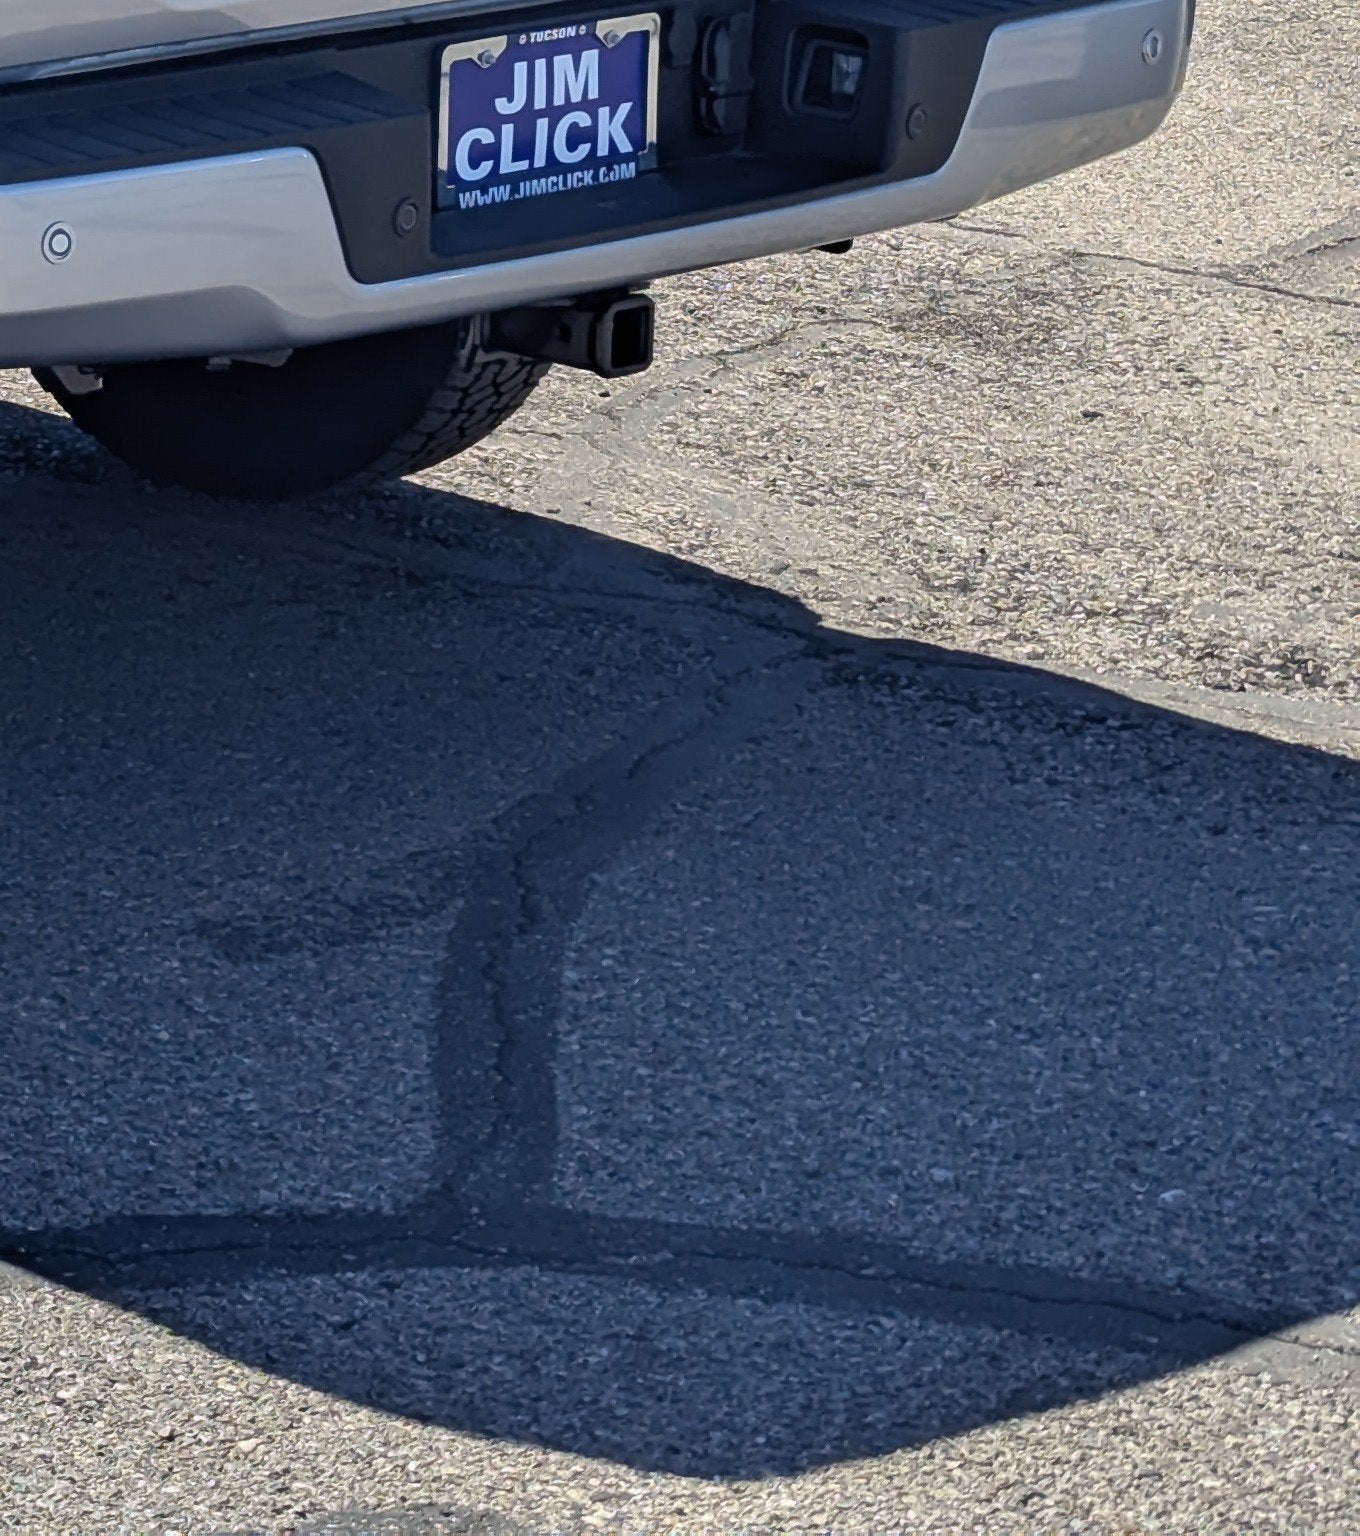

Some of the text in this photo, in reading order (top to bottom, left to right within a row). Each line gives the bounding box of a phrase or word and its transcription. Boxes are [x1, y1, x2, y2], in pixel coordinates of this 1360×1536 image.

[529, 25, 577, 44] TUCSON
[494, 49, 599, 115] JIM
[455, 102, 633, 181] CLICK
[458, 162, 636, 210] WWW.JIMCLICK.COM
